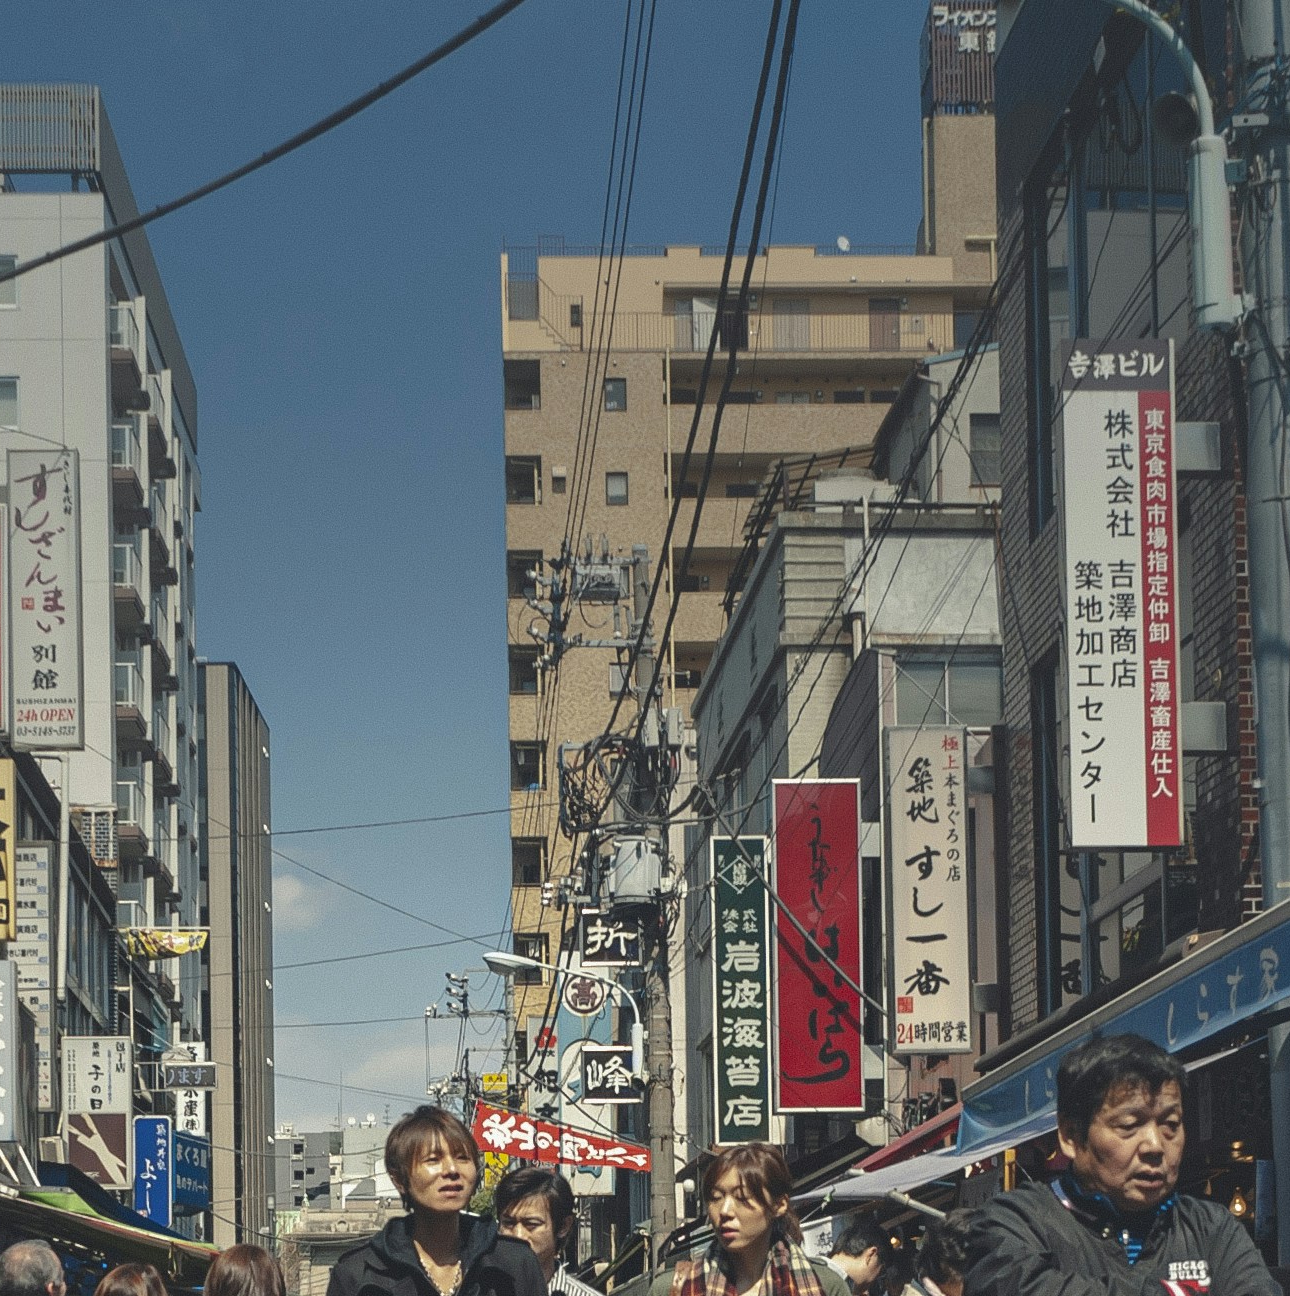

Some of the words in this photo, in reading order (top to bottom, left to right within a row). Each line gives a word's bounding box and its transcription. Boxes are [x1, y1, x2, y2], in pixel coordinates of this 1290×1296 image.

[1103, 408, 1137, 539] 株式会社
[1143, 407, 1172, 644] 東京食肉市場指定仲卸
[32, 644, 58, 691] 別館
[1107, 558, 1139, 690] 吉澤商店
[16, 708, 38, 723] 24h
[39, 707, 75, 722] OPEN
[1073, 559, 1105, 823] 築地加工センター
[1148, 656, 1185, 799] 吉澤畜産仕入
[906, 756, 938, 824] 築地
[941, 733, 961, 883] 極上本まぐろの店
[897, 1021, 968, 1045] 24時間営業
[1169, 1269, 1207, 1280] BULLS
